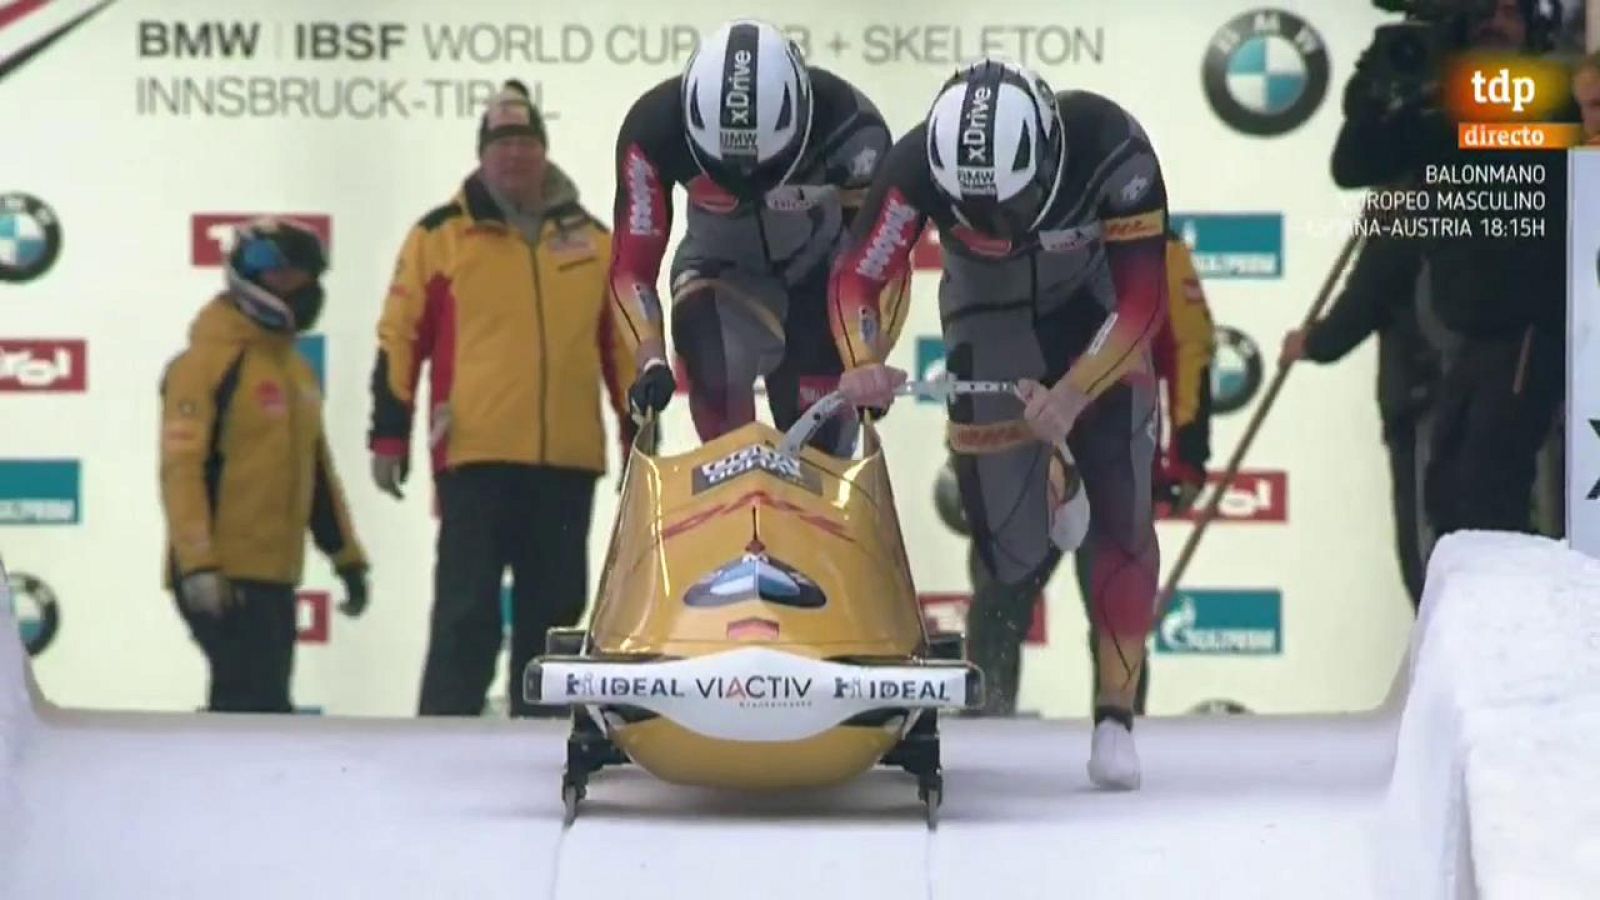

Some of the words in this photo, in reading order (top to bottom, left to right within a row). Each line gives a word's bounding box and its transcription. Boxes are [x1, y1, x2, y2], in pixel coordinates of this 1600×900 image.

[138, 22, 260, 58] BMW
[294, 24, 406, 61] IBSF
[422, 25, 594, 64] WORLD
[605, 26, 700, 65] CUP
[863, 25, 1104, 65] SKELETON
[136, 78, 561, 120] INNSBRUCK-TIRL
[726, 49, 752, 125] xDrive
[963, 86, 992, 162] xDrive
[601, 677, 685, 698] IDEAL
[695, 675, 813, 699] VIACTIV
[869, 679, 950, 701] IDEAL
